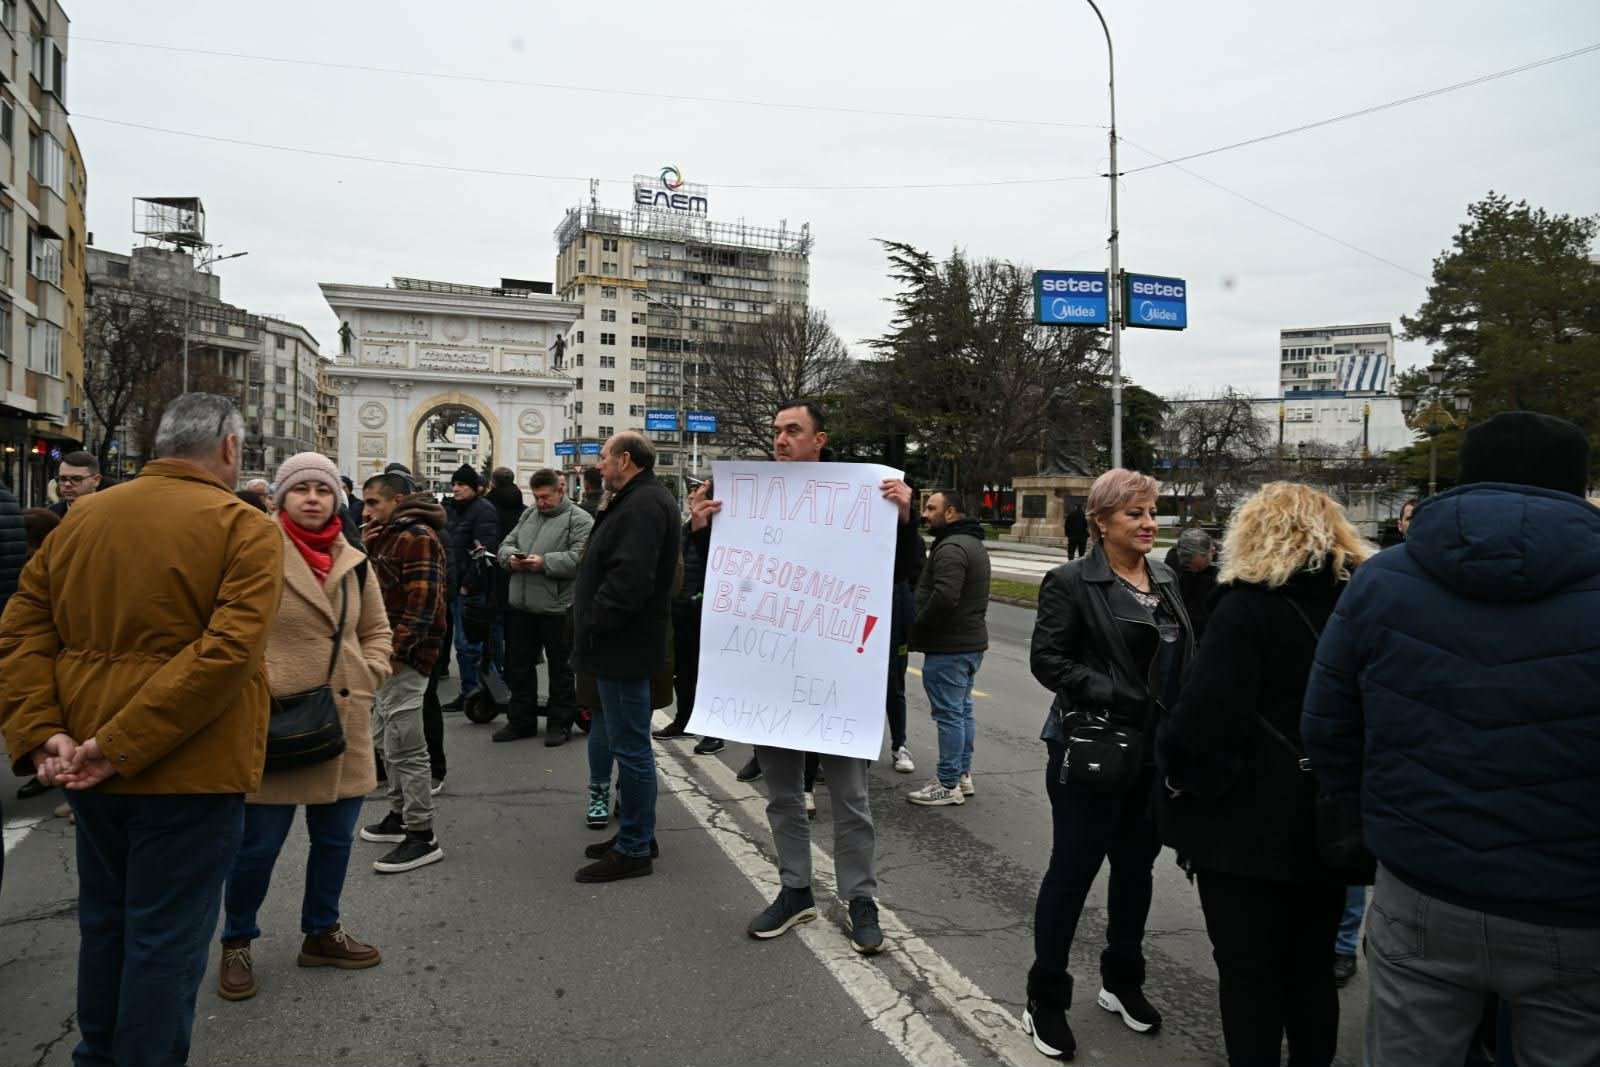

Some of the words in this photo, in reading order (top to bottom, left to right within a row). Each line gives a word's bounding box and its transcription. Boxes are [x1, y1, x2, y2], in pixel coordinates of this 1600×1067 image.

[1042, 278, 1103, 293] setec
[1133, 281, 1184, 297] setec
[1054, 301, 1096, 318] Midea
[1142, 303, 1177, 320] Midea
[731, 472, 872, 532] ПЛАТА
[710, 546, 871, 613] ОБРАЗОВАНИЕ
[719, 624, 800, 669] ДОСТА
[706, 696, 793, 735] РОНКИ
[804, 712, 857, 744] ЛЕБ
